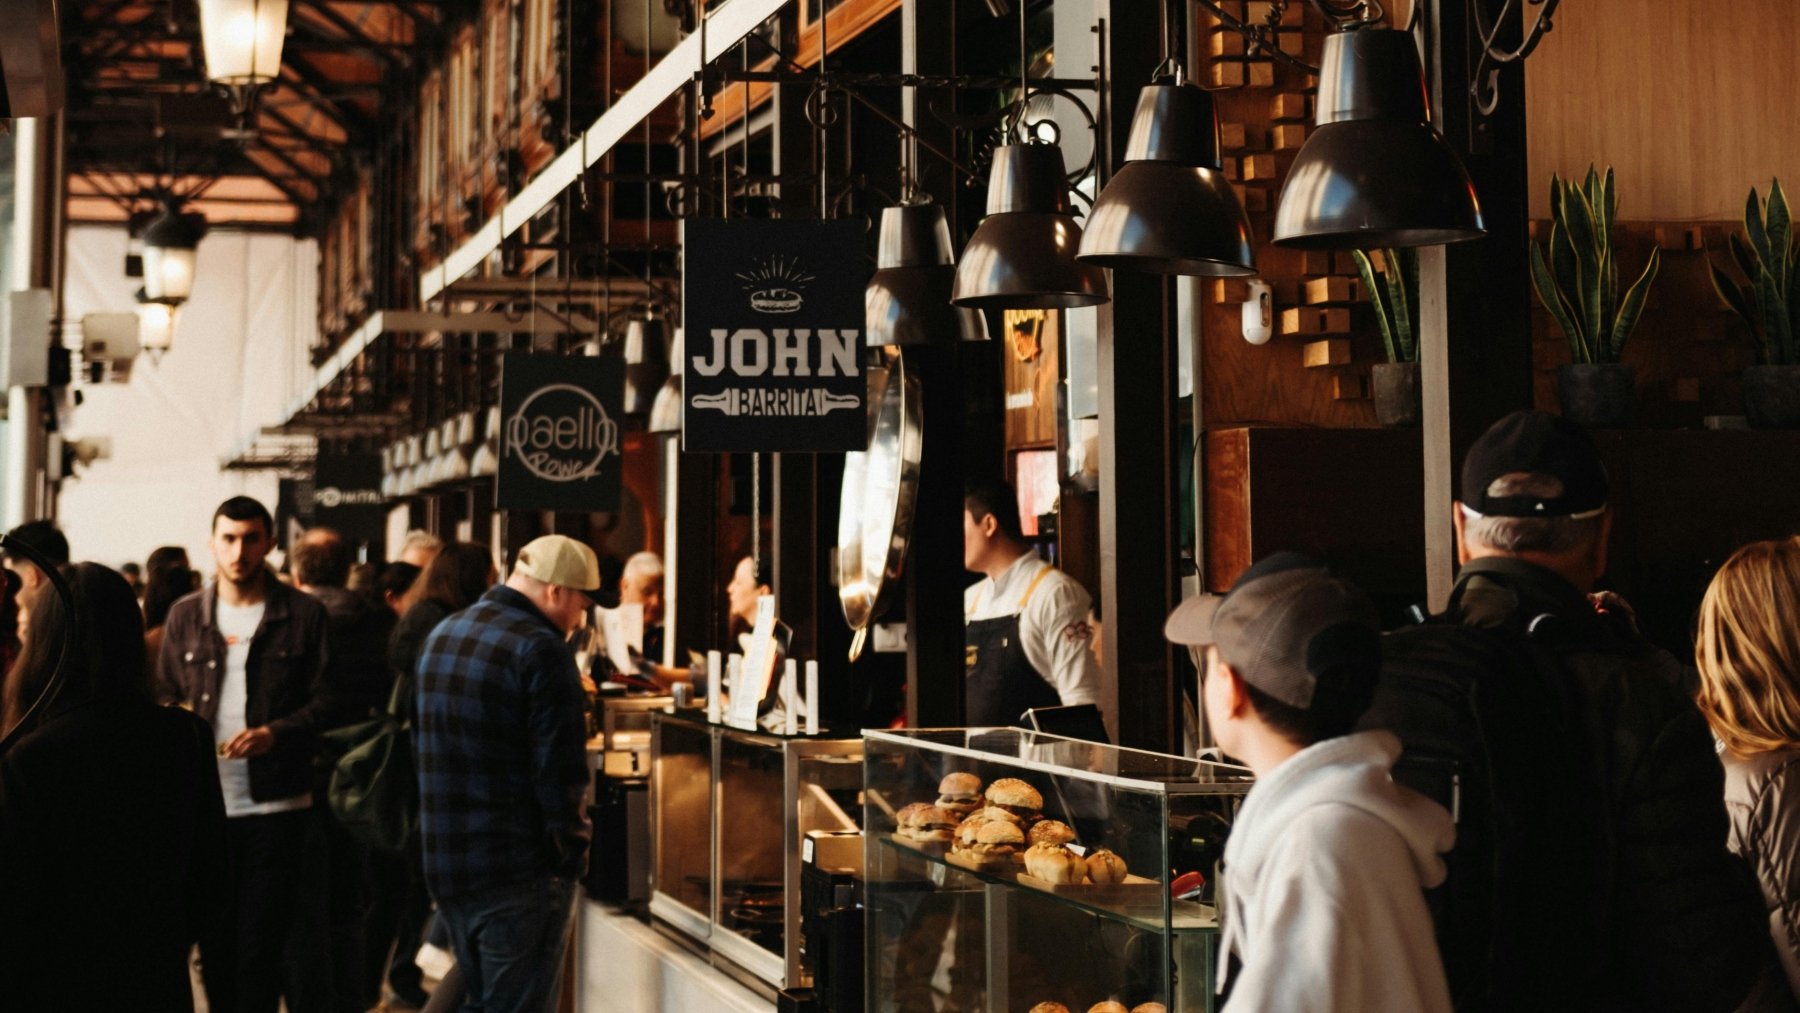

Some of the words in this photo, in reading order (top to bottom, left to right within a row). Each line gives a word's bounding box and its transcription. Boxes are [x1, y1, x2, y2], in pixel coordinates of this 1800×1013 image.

[692, 329, 859, 377] JOHN
[739, 388, 817, 415] BARRITA
[505, 407, 619, 458] paella
